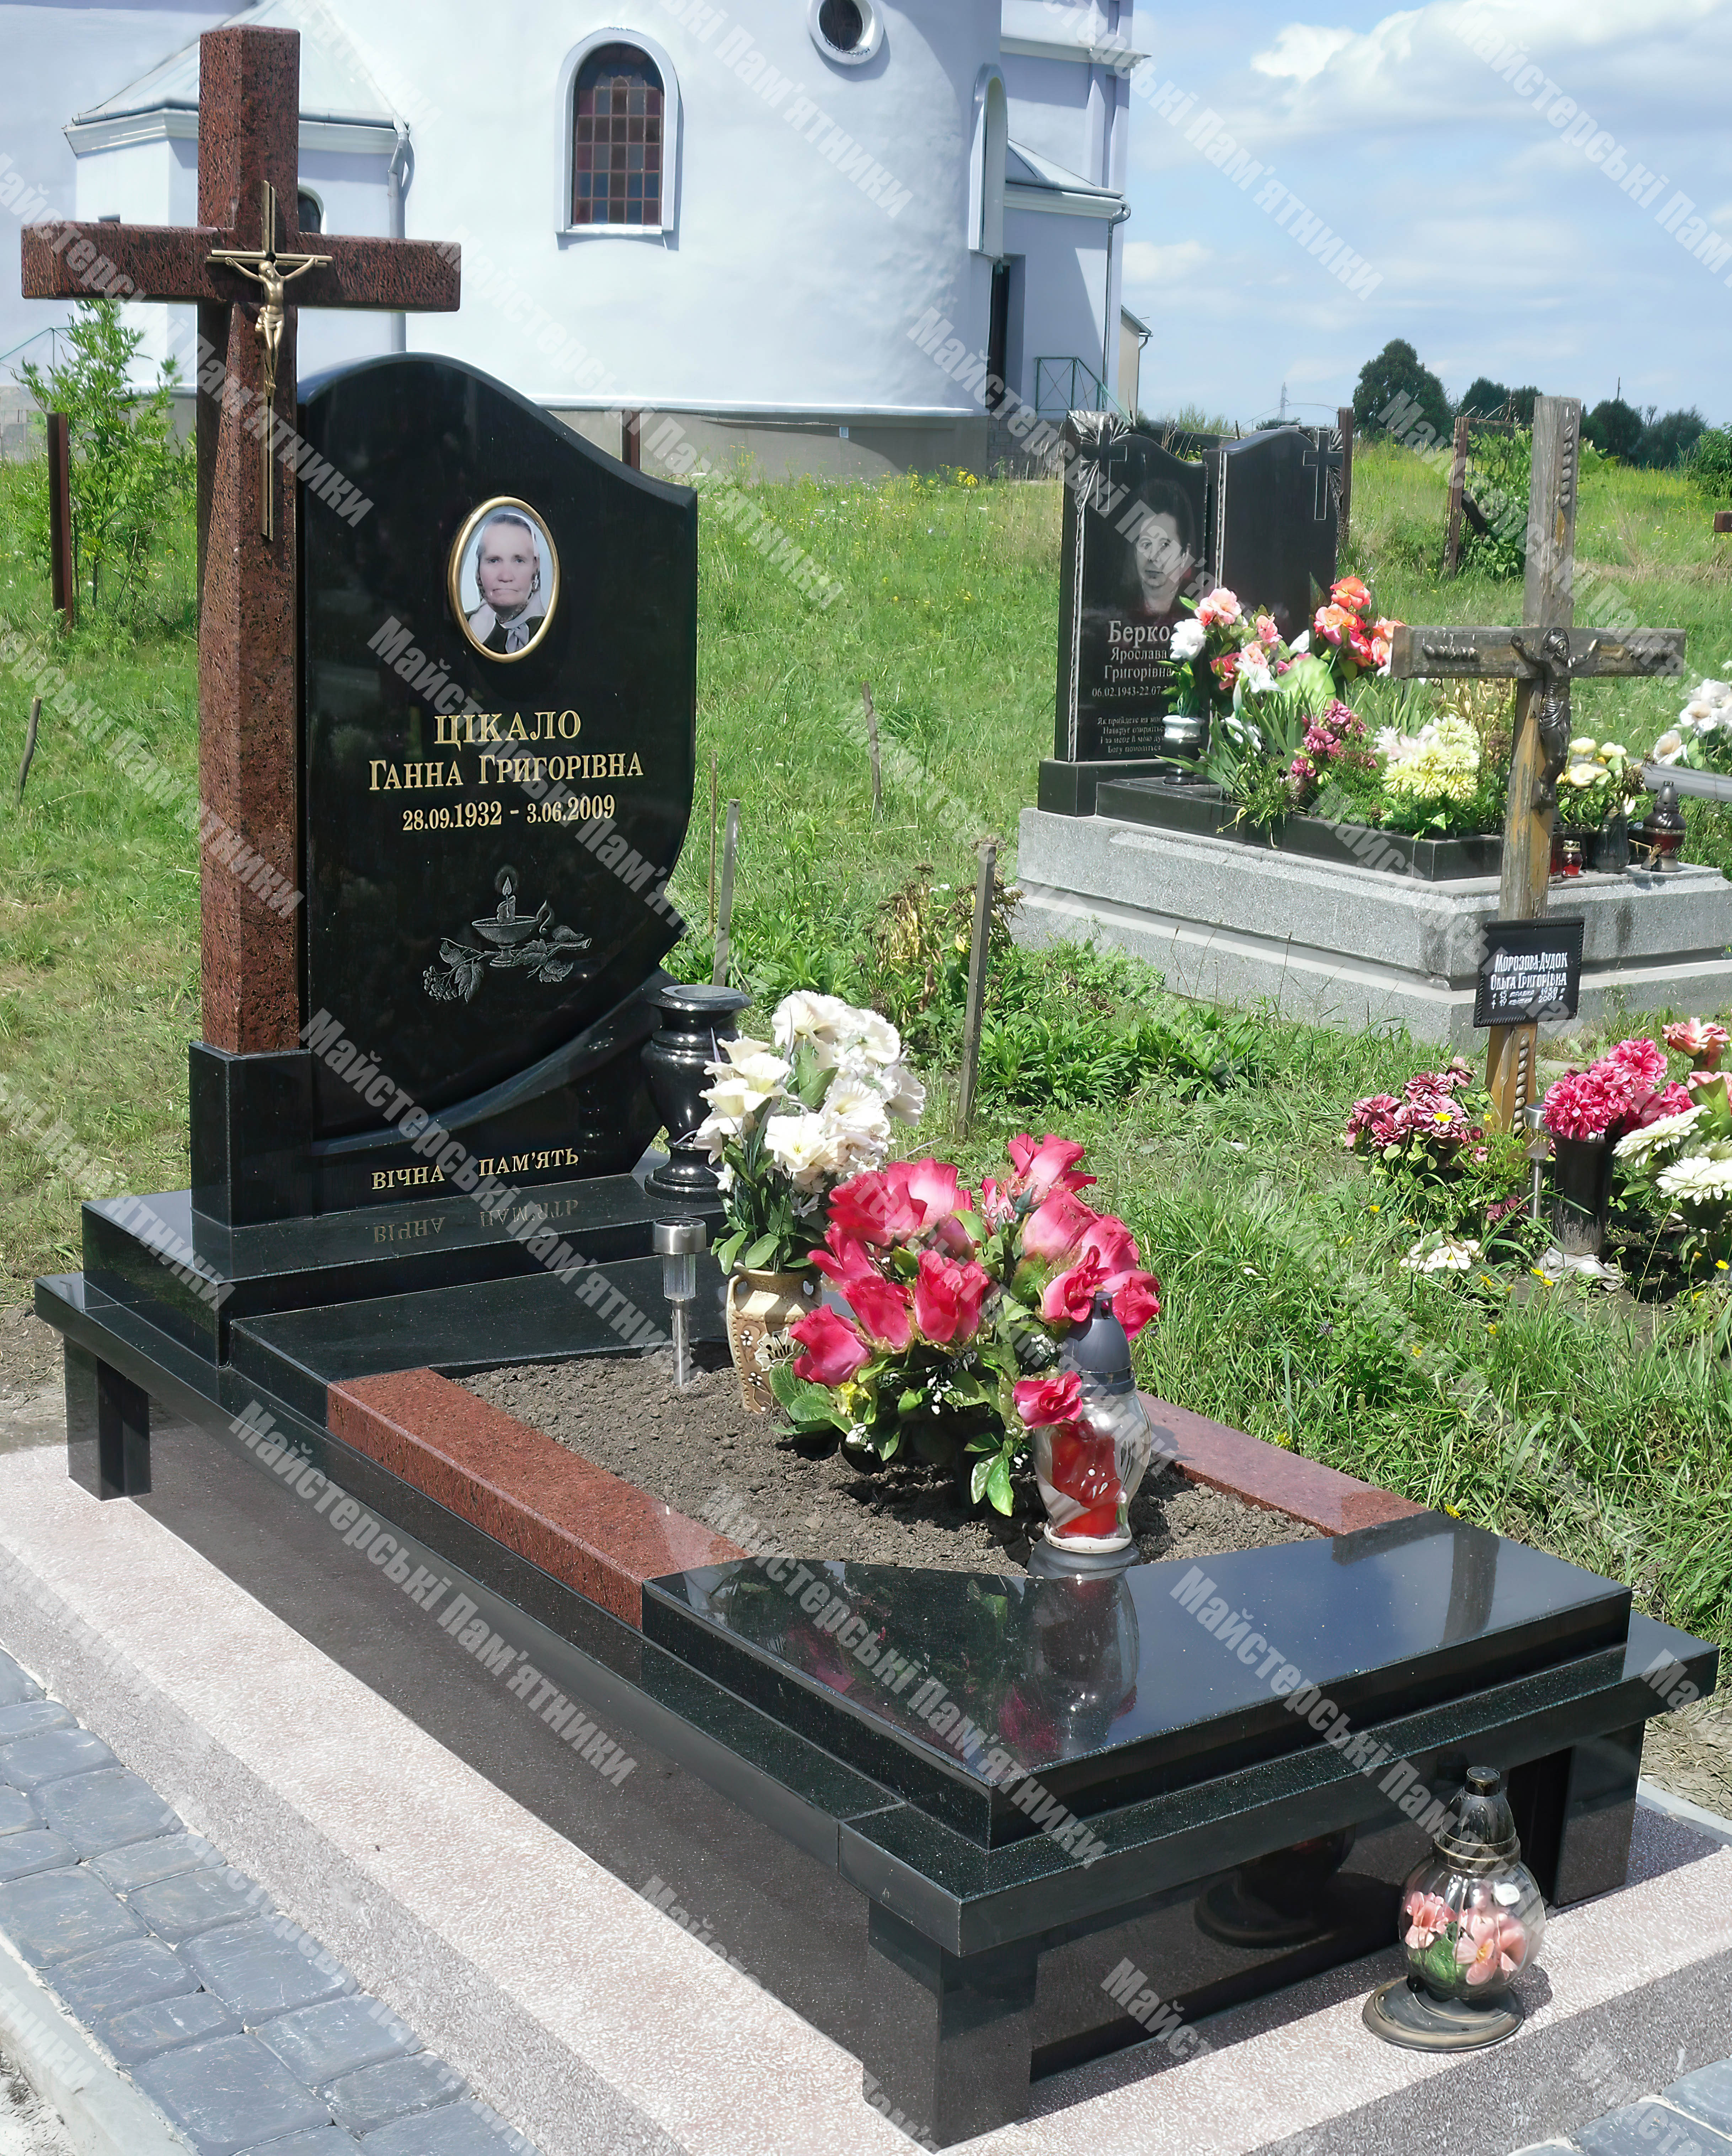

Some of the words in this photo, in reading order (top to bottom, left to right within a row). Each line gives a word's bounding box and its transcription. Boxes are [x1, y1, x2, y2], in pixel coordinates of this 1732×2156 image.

[1108, 621, 1170, 648] Берко
[1111, 647, 1167, 663] Ярослава
[1092, 686, 1176, 697] 06.02.1943-22.07
[434, 710, 581, 751] ЦІКАЛО
[369, 760, 463, 790] ГАННА
[479, 752, 644, 784] ГРИГОРІВНА
[402, 801, 502, 831] 28.09.1932
[527, 794, 615, 824] 3.06.2009
[372, 1164, 445, 1190] ВІЧНА
[479, 1148, 579, 1176] ПАМ'ЯТЬ
